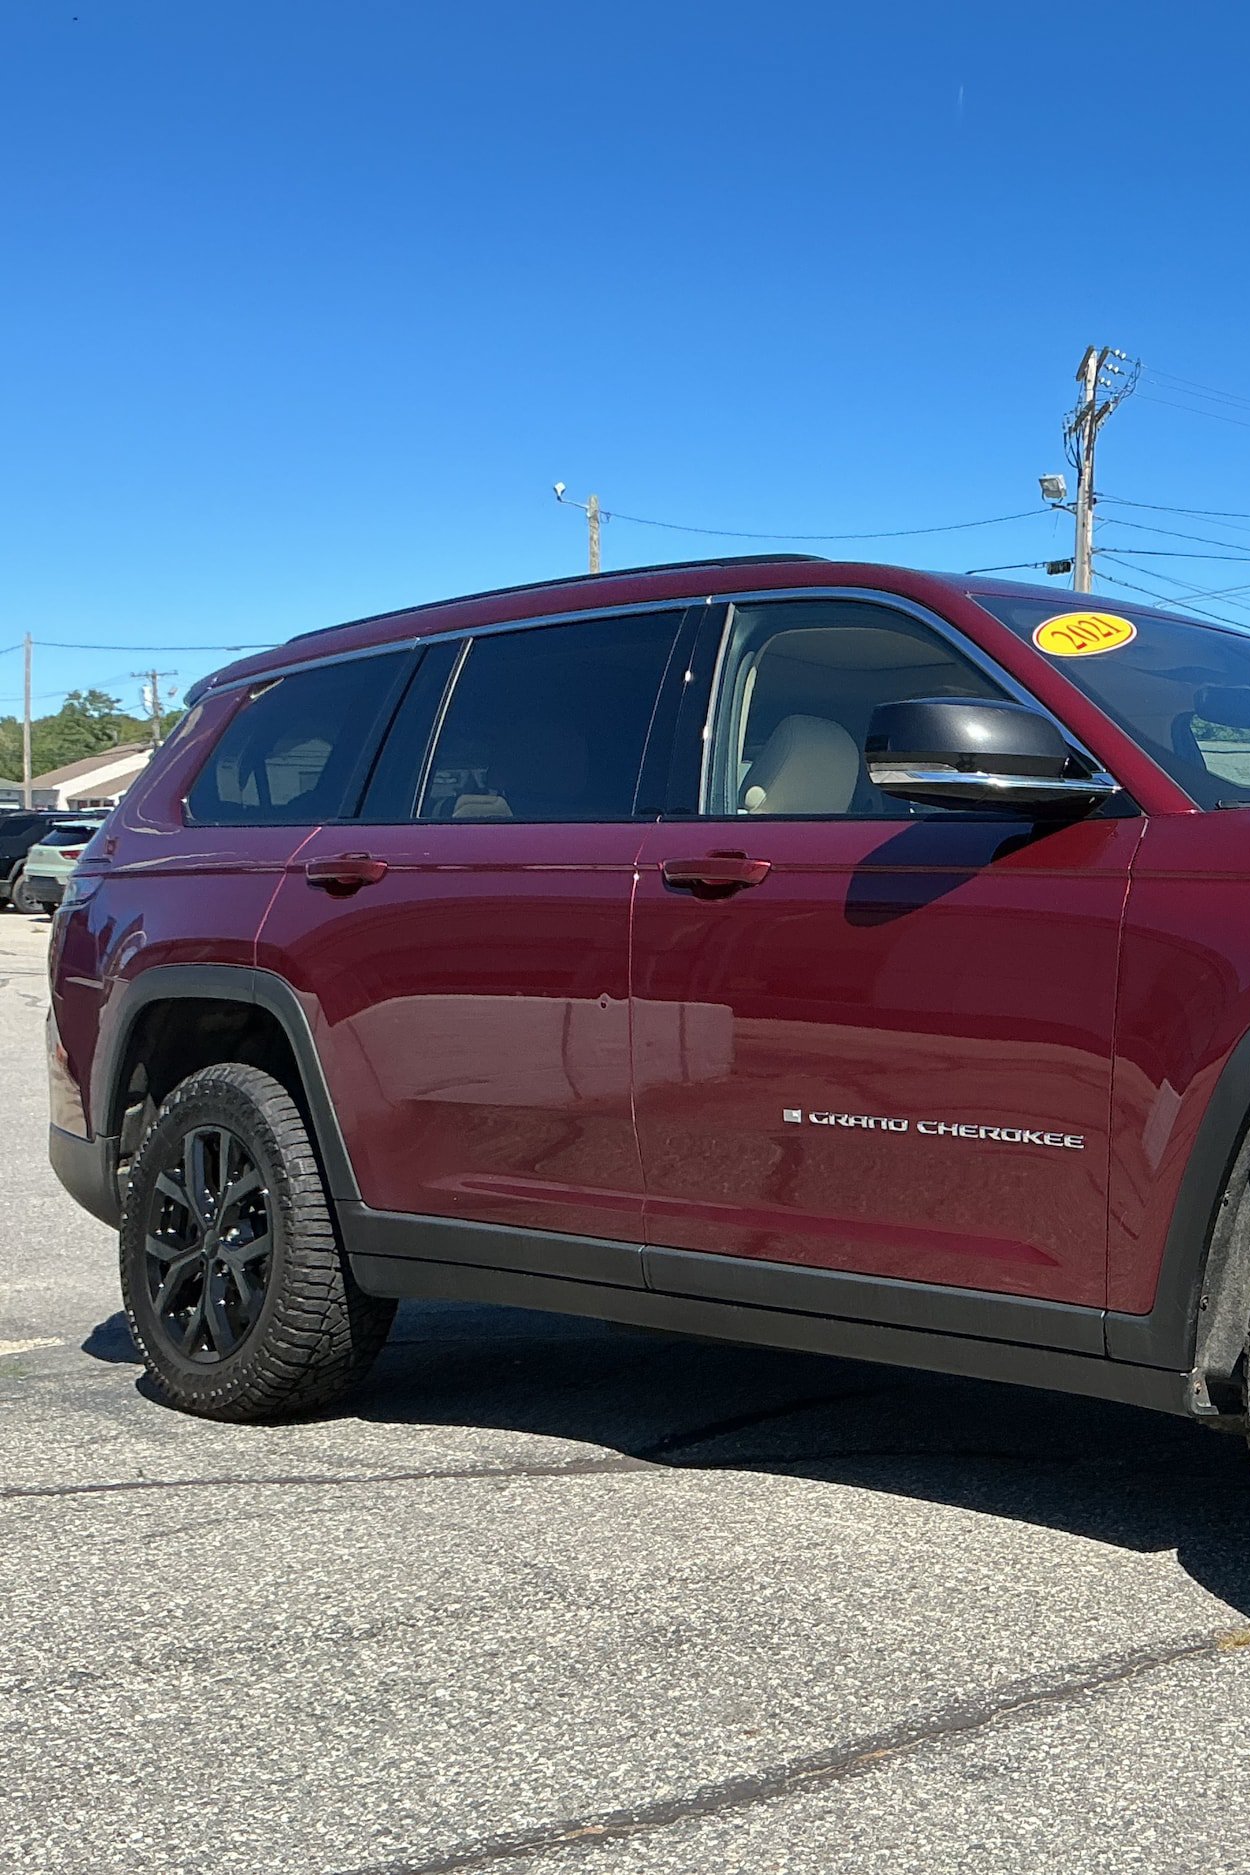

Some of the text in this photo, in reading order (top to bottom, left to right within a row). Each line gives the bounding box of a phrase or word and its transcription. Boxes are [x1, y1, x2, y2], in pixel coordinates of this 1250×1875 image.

[1050, 616, 1124, 650] 2021
[808, 1111, 1085, 1149] GRAND CHEROKEE
